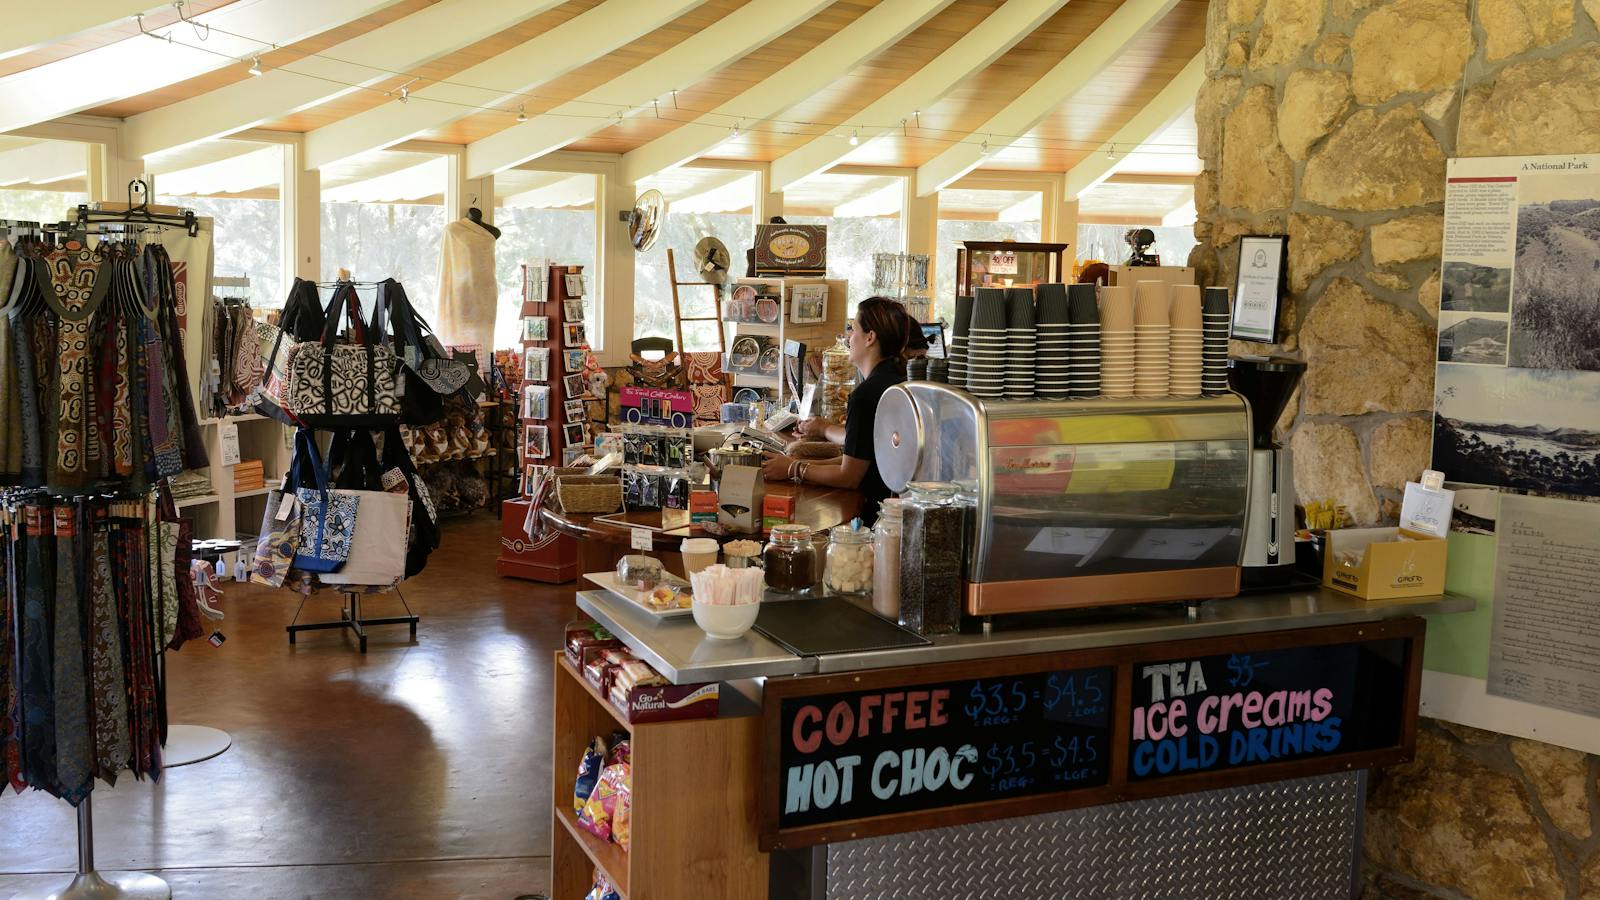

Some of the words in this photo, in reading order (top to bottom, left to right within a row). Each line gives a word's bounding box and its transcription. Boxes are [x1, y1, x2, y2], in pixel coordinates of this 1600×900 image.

[1530, 162, 1566, 170] National
[1567, 161, 1589, 169] Park
[1003, 256, 1015, 264] OFF
[638, 693, 653, 703] Go
[1142, 659, 1208, 703] TEA
[632, 699, 666, 712] Natural
[791, 688, 950, 755] COFFEE
[963, 680, 1028, 721] $3.5
[1043, 673, 1104, 712] $4.5
[1196, 687, 1334, 735] creams
[1132, 733, 1220, 777] COLD
[1228, 716, 1343, 765] DRINKS
[784, 754, 862, 816] HOT
[870, 743, 980, 801] CHOC
[982, 742, 1037, 779] $3.5
[1050, 735, 1098, 769] $4.5
